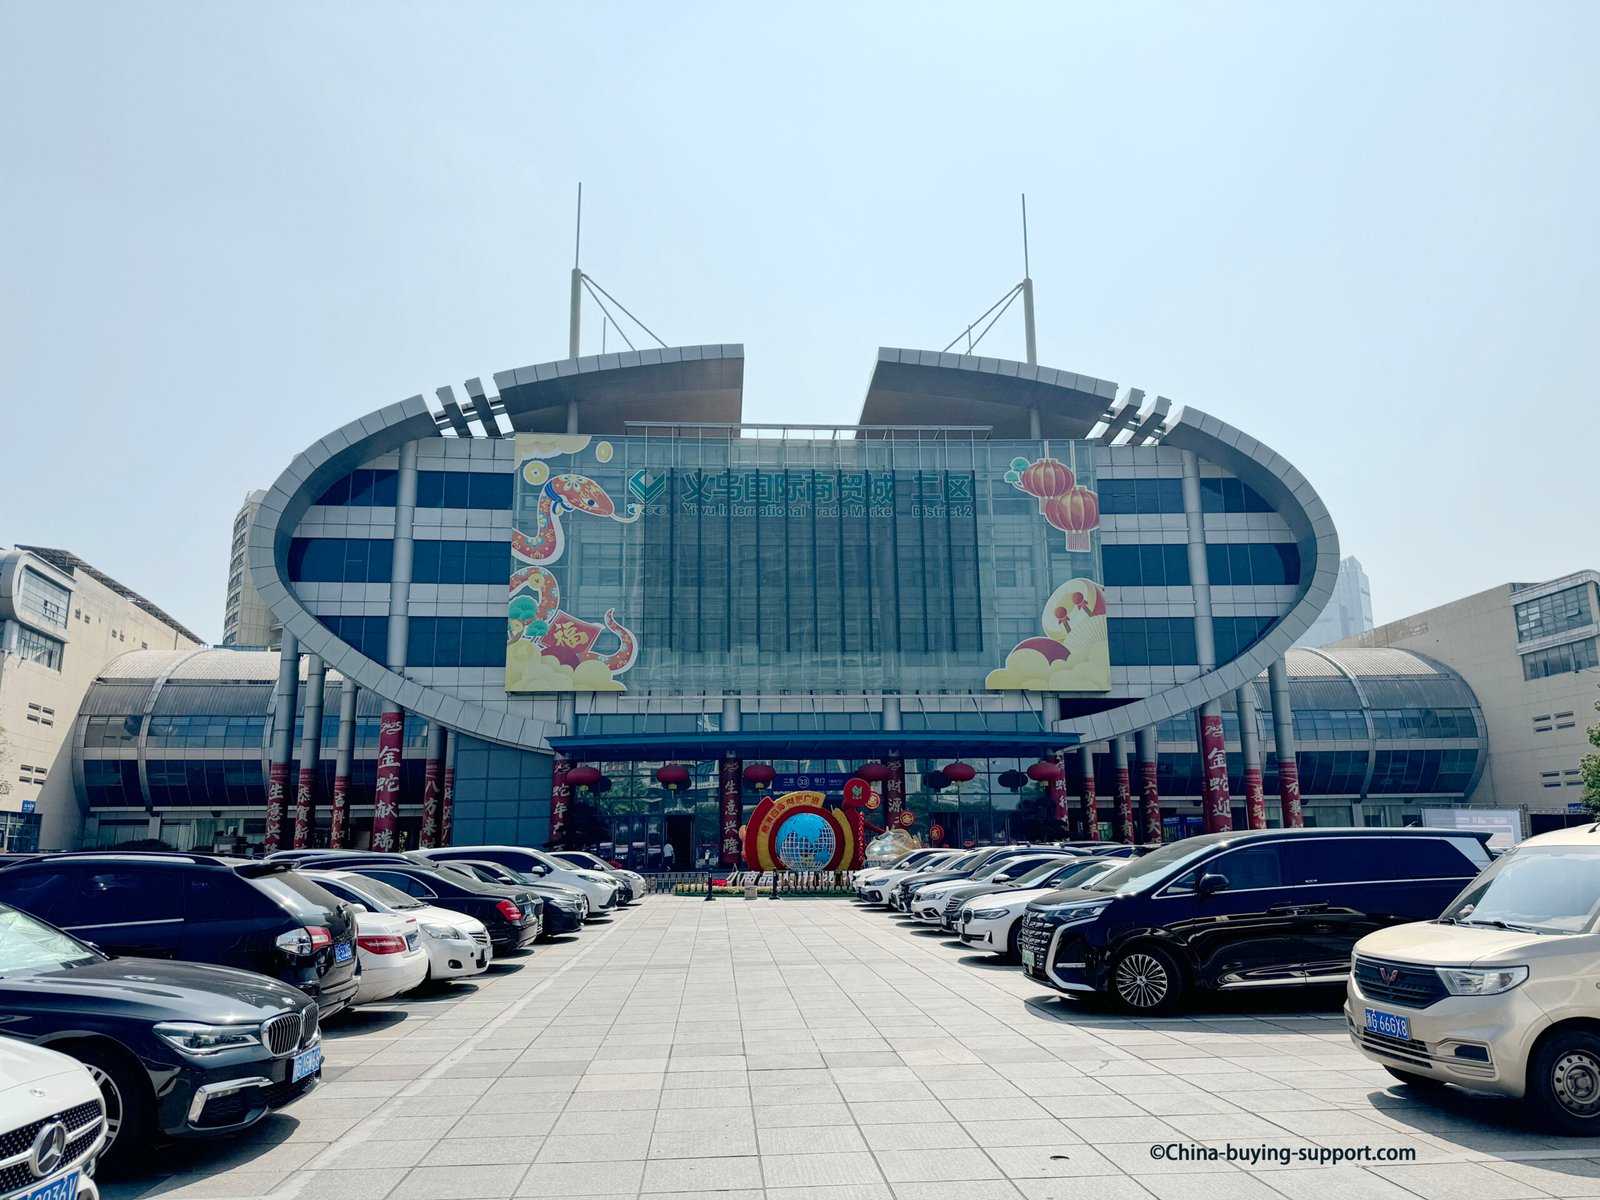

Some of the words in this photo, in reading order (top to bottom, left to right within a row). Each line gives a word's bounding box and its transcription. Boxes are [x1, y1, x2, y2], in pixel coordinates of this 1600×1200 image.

[682, 472, 895, 502] 义乌国际商贸城
[911, 474, 973, 502] 二区
[850, 504, 894, 517] Marke
[963, 504, 973, 517] 2
[553, 621, 590, 650] 福
[373, 745, 401, 853] 金蛇献瑞
[723, 779, 740, 855] 生意兴隆
